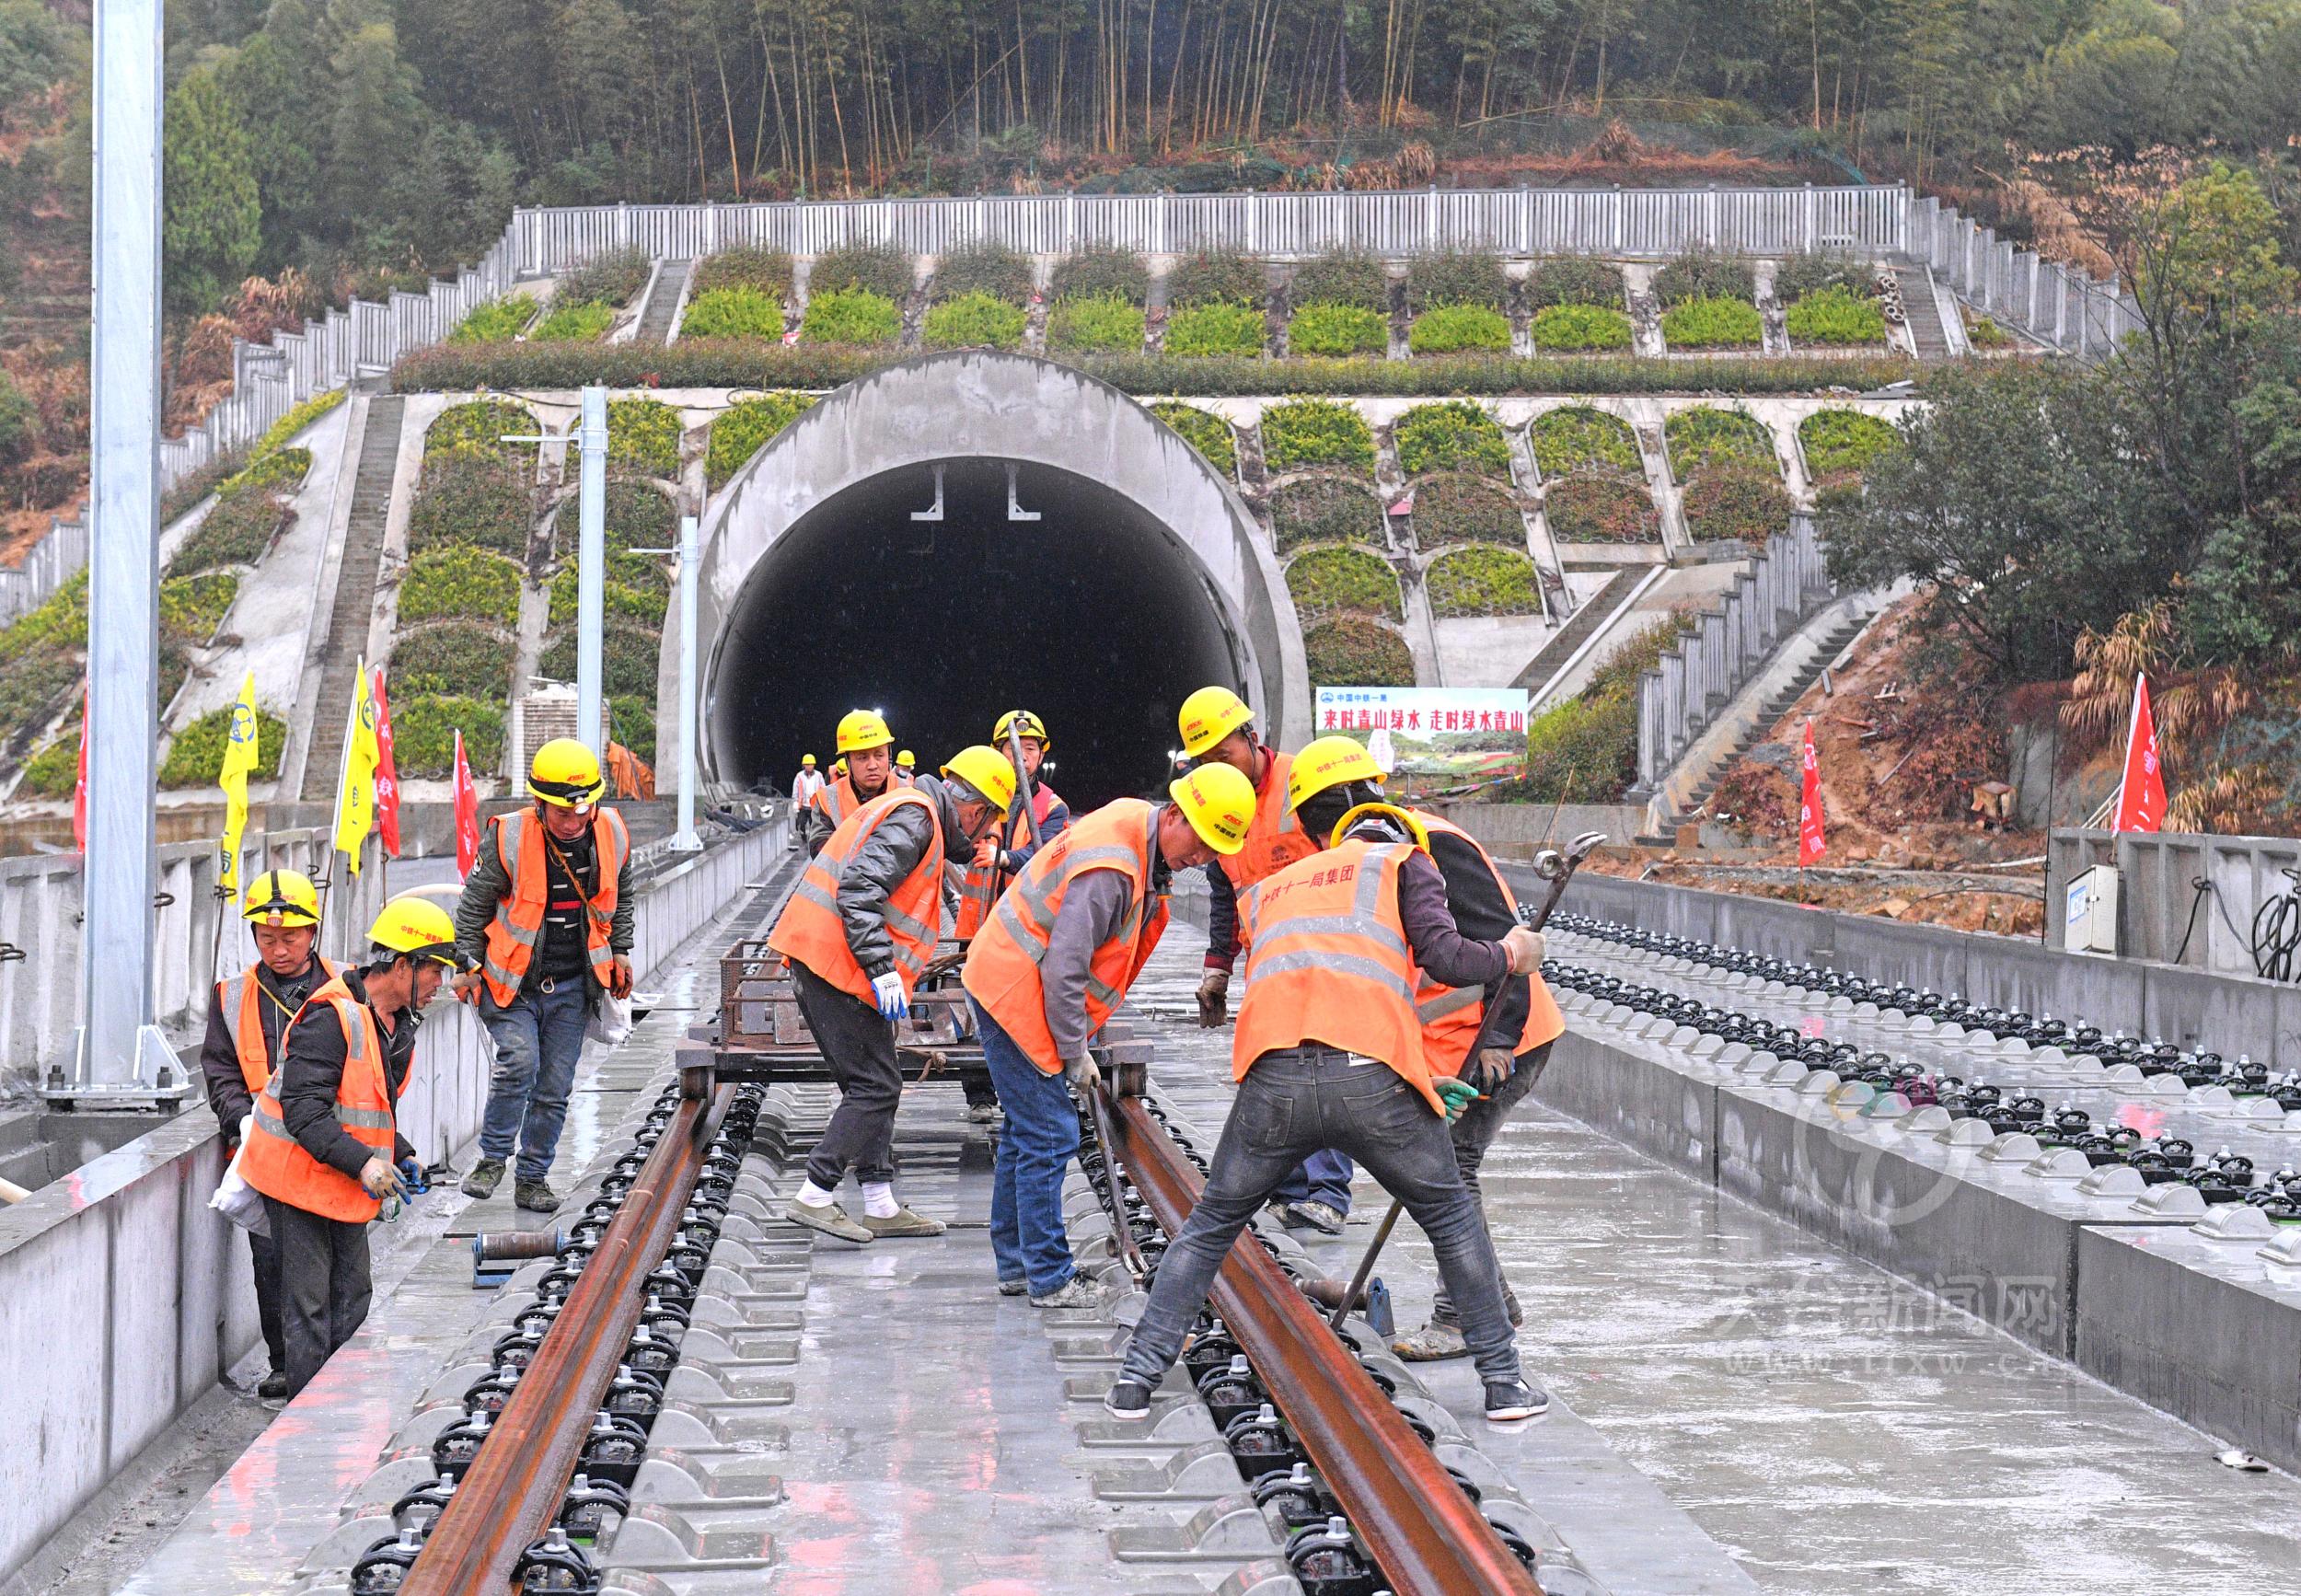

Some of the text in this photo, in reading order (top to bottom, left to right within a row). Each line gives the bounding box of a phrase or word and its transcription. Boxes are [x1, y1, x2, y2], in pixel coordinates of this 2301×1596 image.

[1336, 693, 1388, 702] 中国中铁一局
[1324, 709, 1524, 733] 来时青山绿水 走时绿水青山
[1316, 753, 1362, 774] 中铁十一局集团
